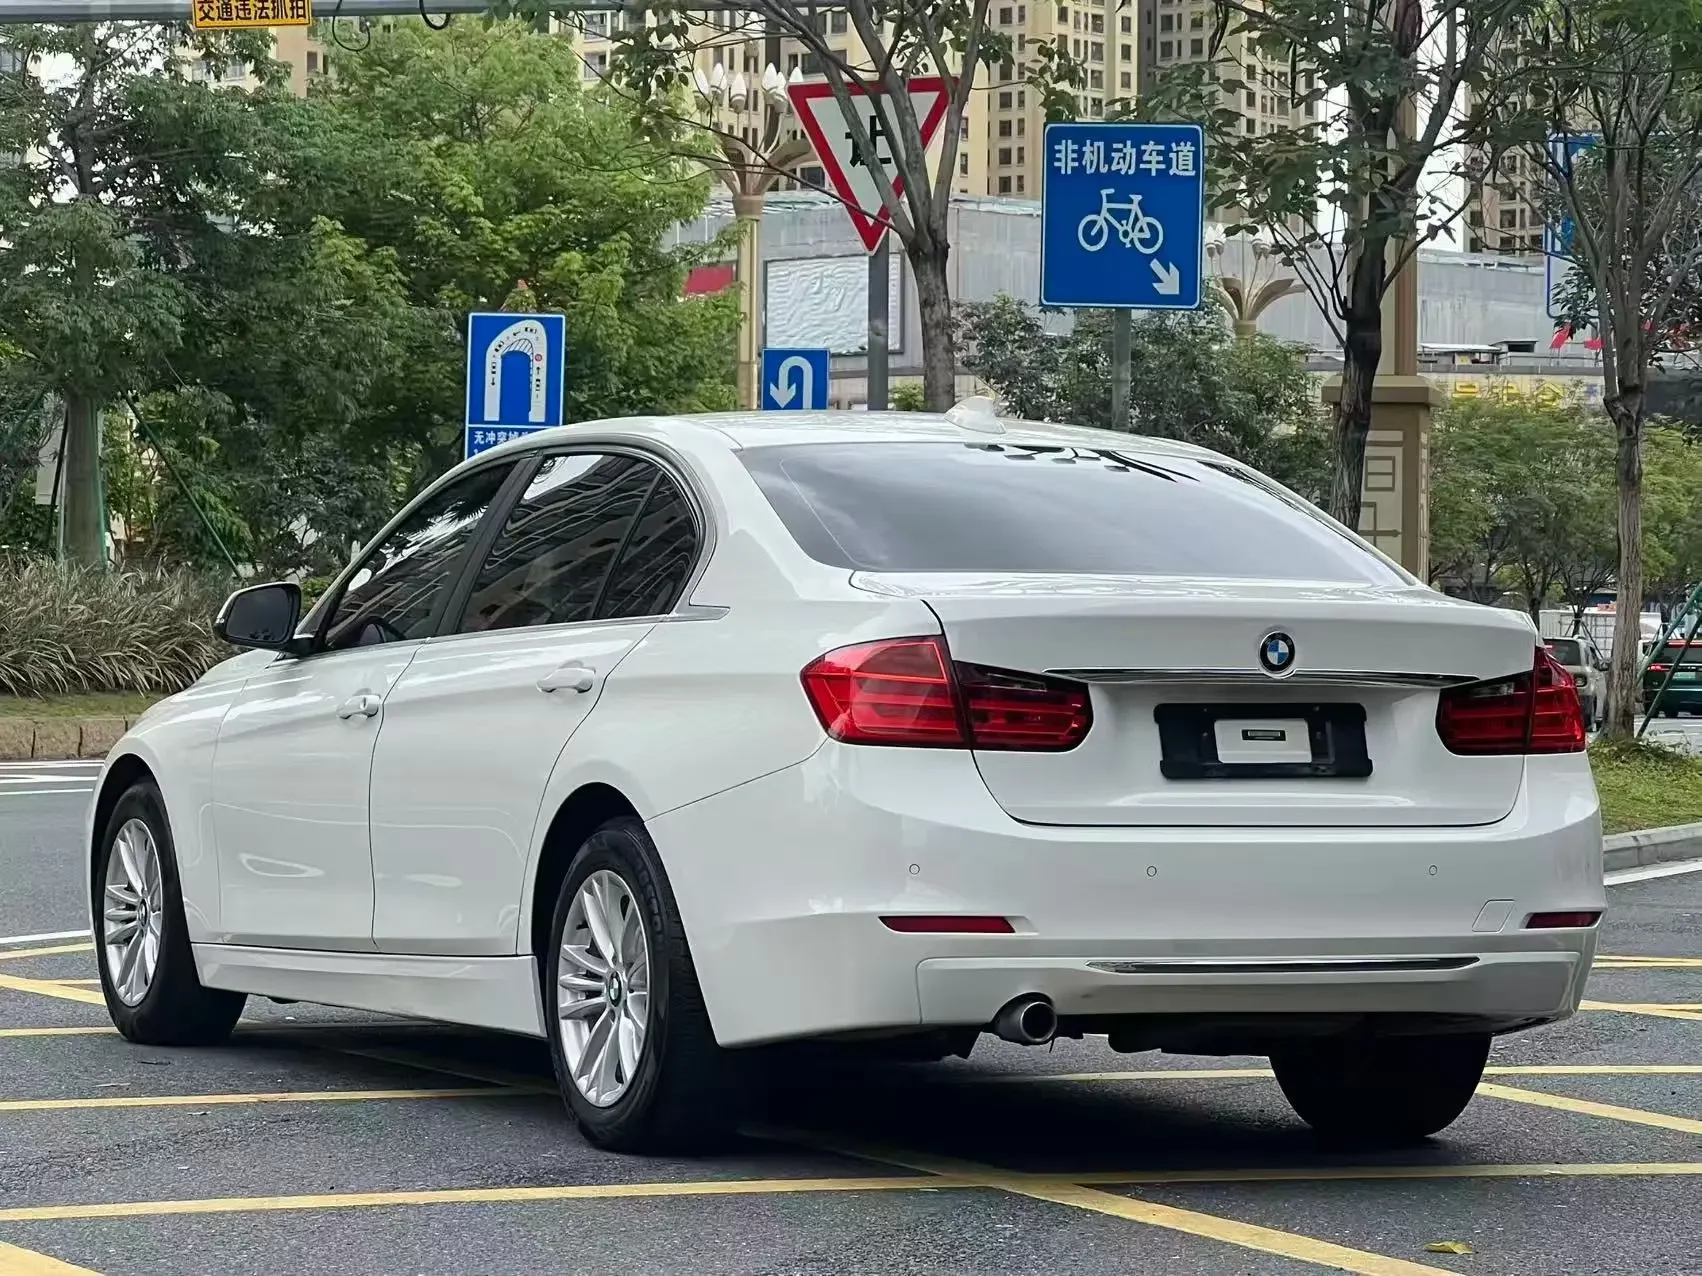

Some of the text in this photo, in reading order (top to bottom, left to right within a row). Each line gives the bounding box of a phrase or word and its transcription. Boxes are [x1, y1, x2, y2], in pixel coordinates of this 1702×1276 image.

[198, 0, 307, 21] 交通违法抓拍
[1053, 139, 1196, 176] 非机动车道
